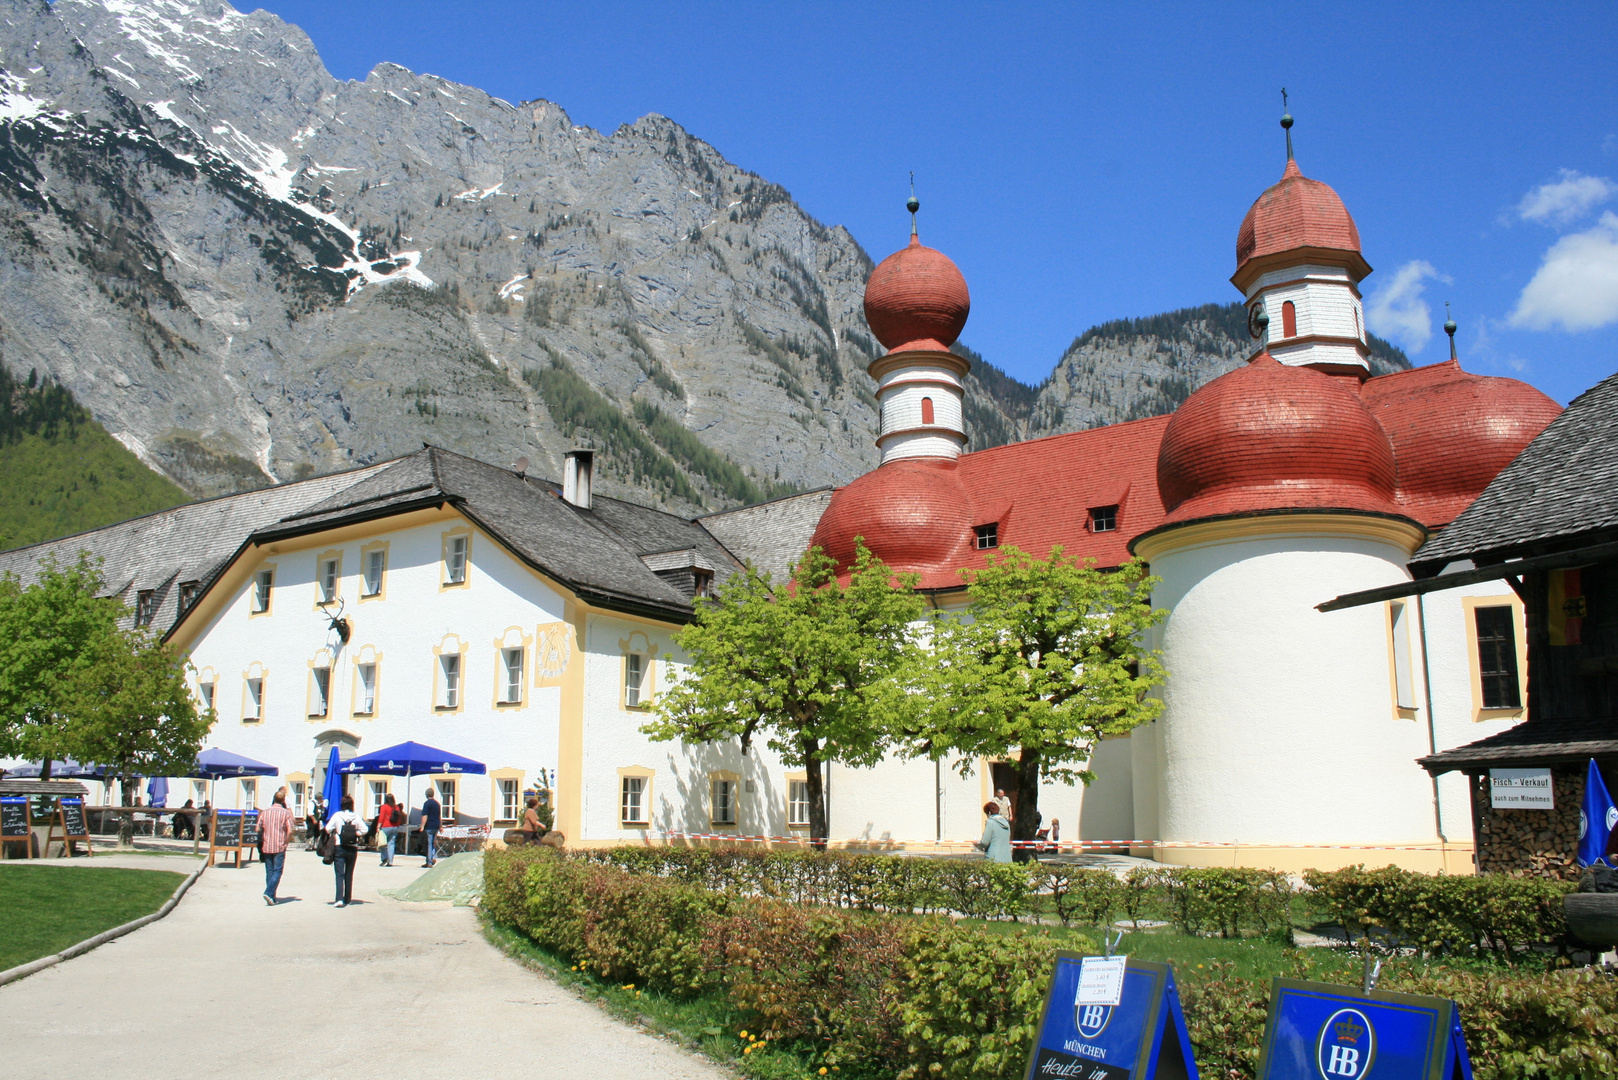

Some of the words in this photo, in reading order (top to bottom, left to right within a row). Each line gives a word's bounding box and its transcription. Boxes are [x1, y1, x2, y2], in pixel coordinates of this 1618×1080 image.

[1494, 778, 1512, 786] Fisch
[1520, 778, 1548, 787] Verkauf
[1081, 1005, 1104, 1029] HB
[1063, 1039, 1107, 1059] MÜNCHEN
[1041, 1057, 1083, 1077] Heute
[1327, 1044, 1359, 1077] HB
